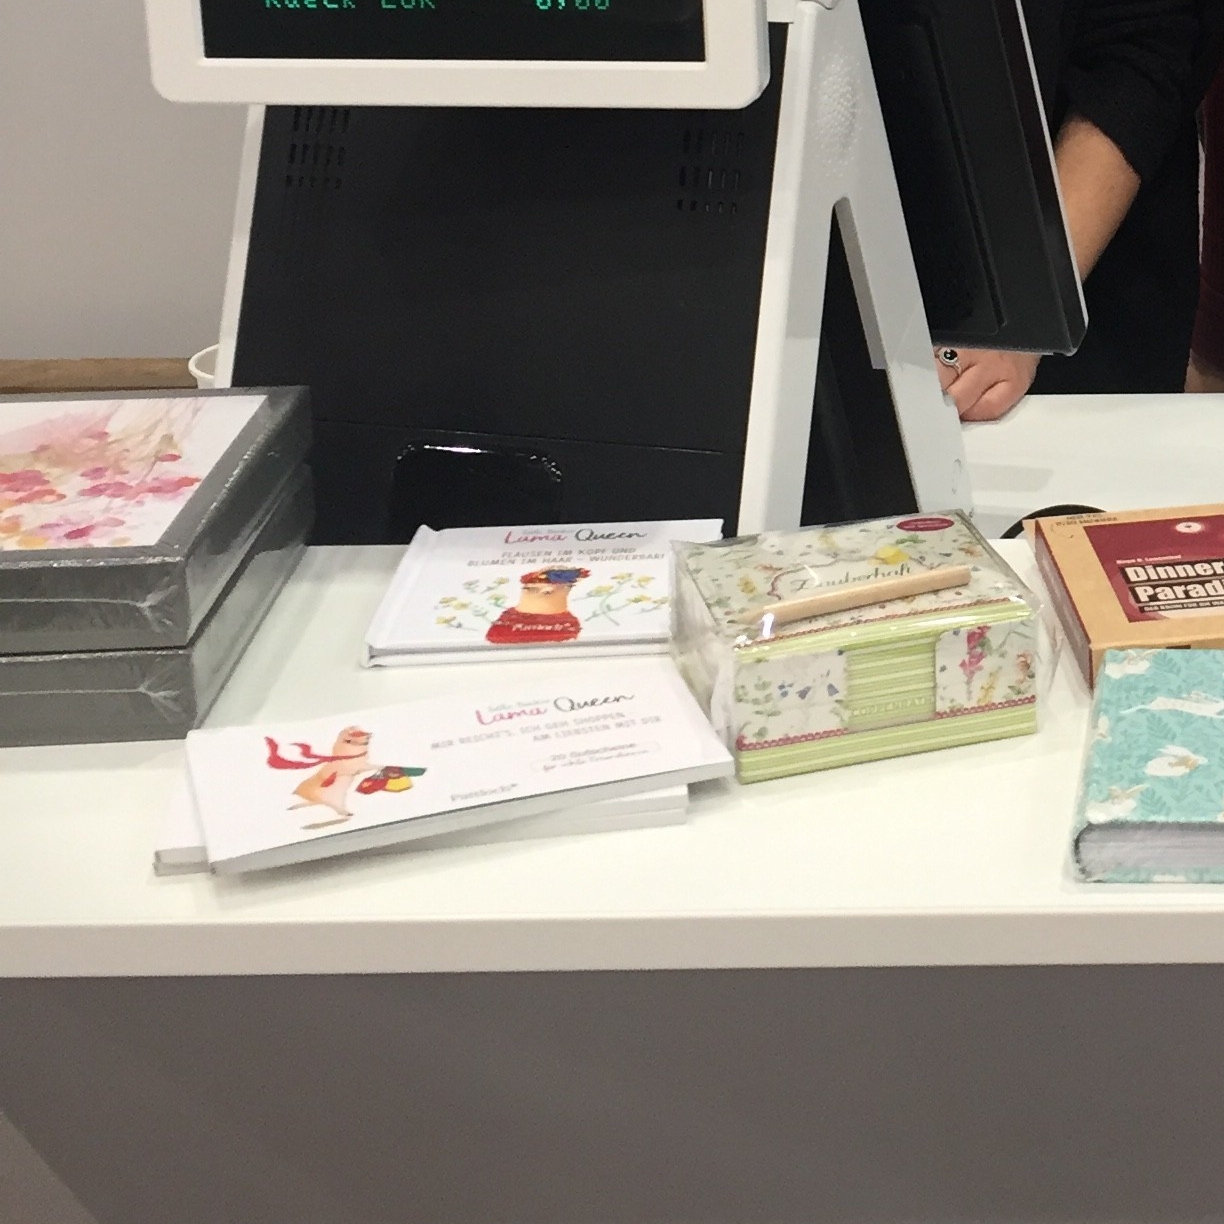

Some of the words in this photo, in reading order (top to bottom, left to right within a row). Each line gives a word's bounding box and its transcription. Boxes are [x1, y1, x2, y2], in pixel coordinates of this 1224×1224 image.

[504, 530, 568, 544] Lama
[574, 528, 648, 542] Queen
[1125, 560, 1224, 582] Dinner
[475, 707, 548, 726] Lama
[553, 693, 635, 713] Queen
